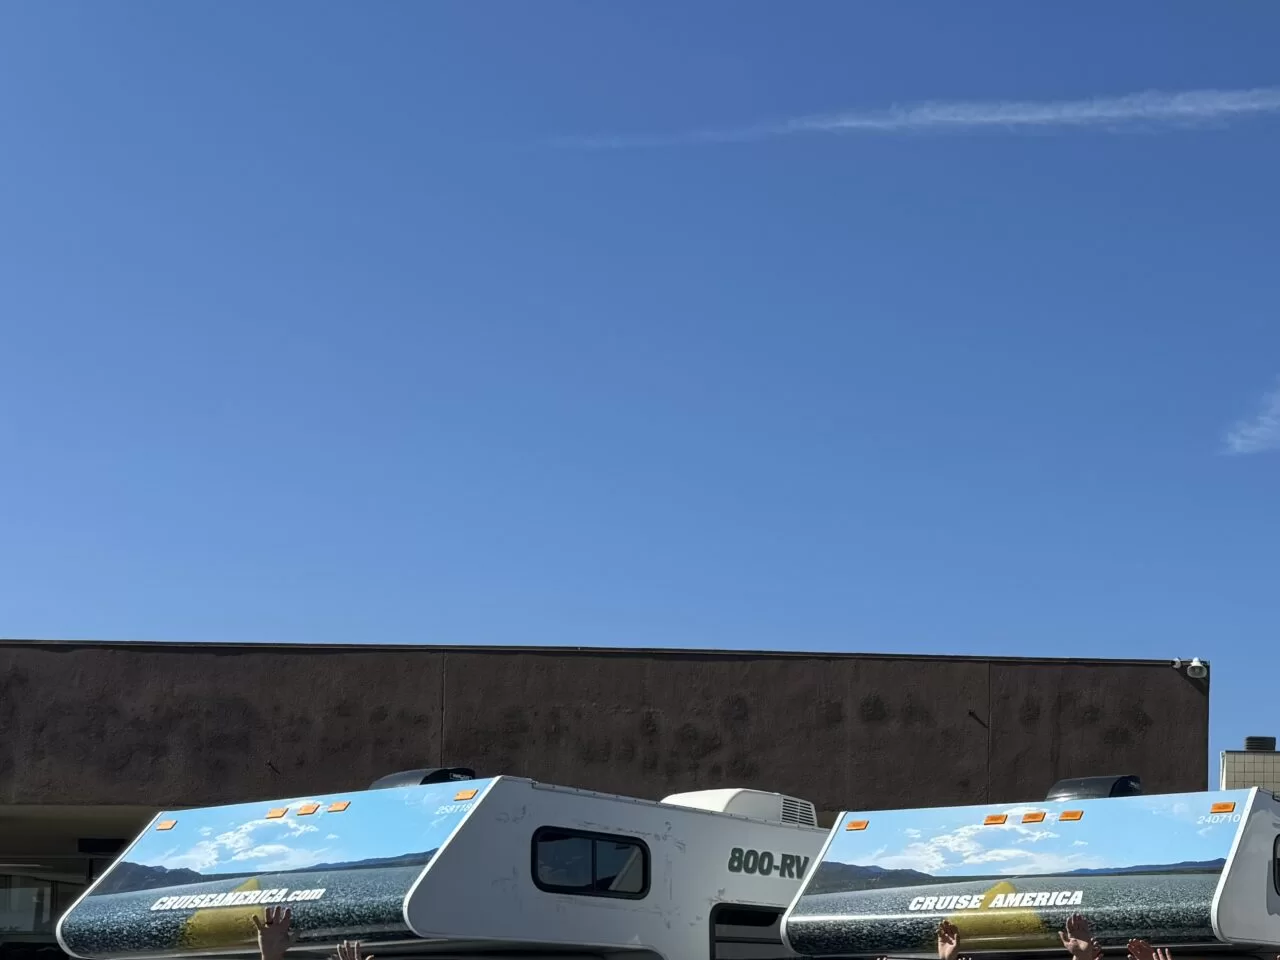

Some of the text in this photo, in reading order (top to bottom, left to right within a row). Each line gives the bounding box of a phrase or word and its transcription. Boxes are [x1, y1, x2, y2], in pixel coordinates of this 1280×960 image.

[1197, 814, 1241, 825] 240710
[150, 888, 326, 911] CRUISEAMERICA.com
[909, 890, 1083, 911] CRUISE AMERICA
